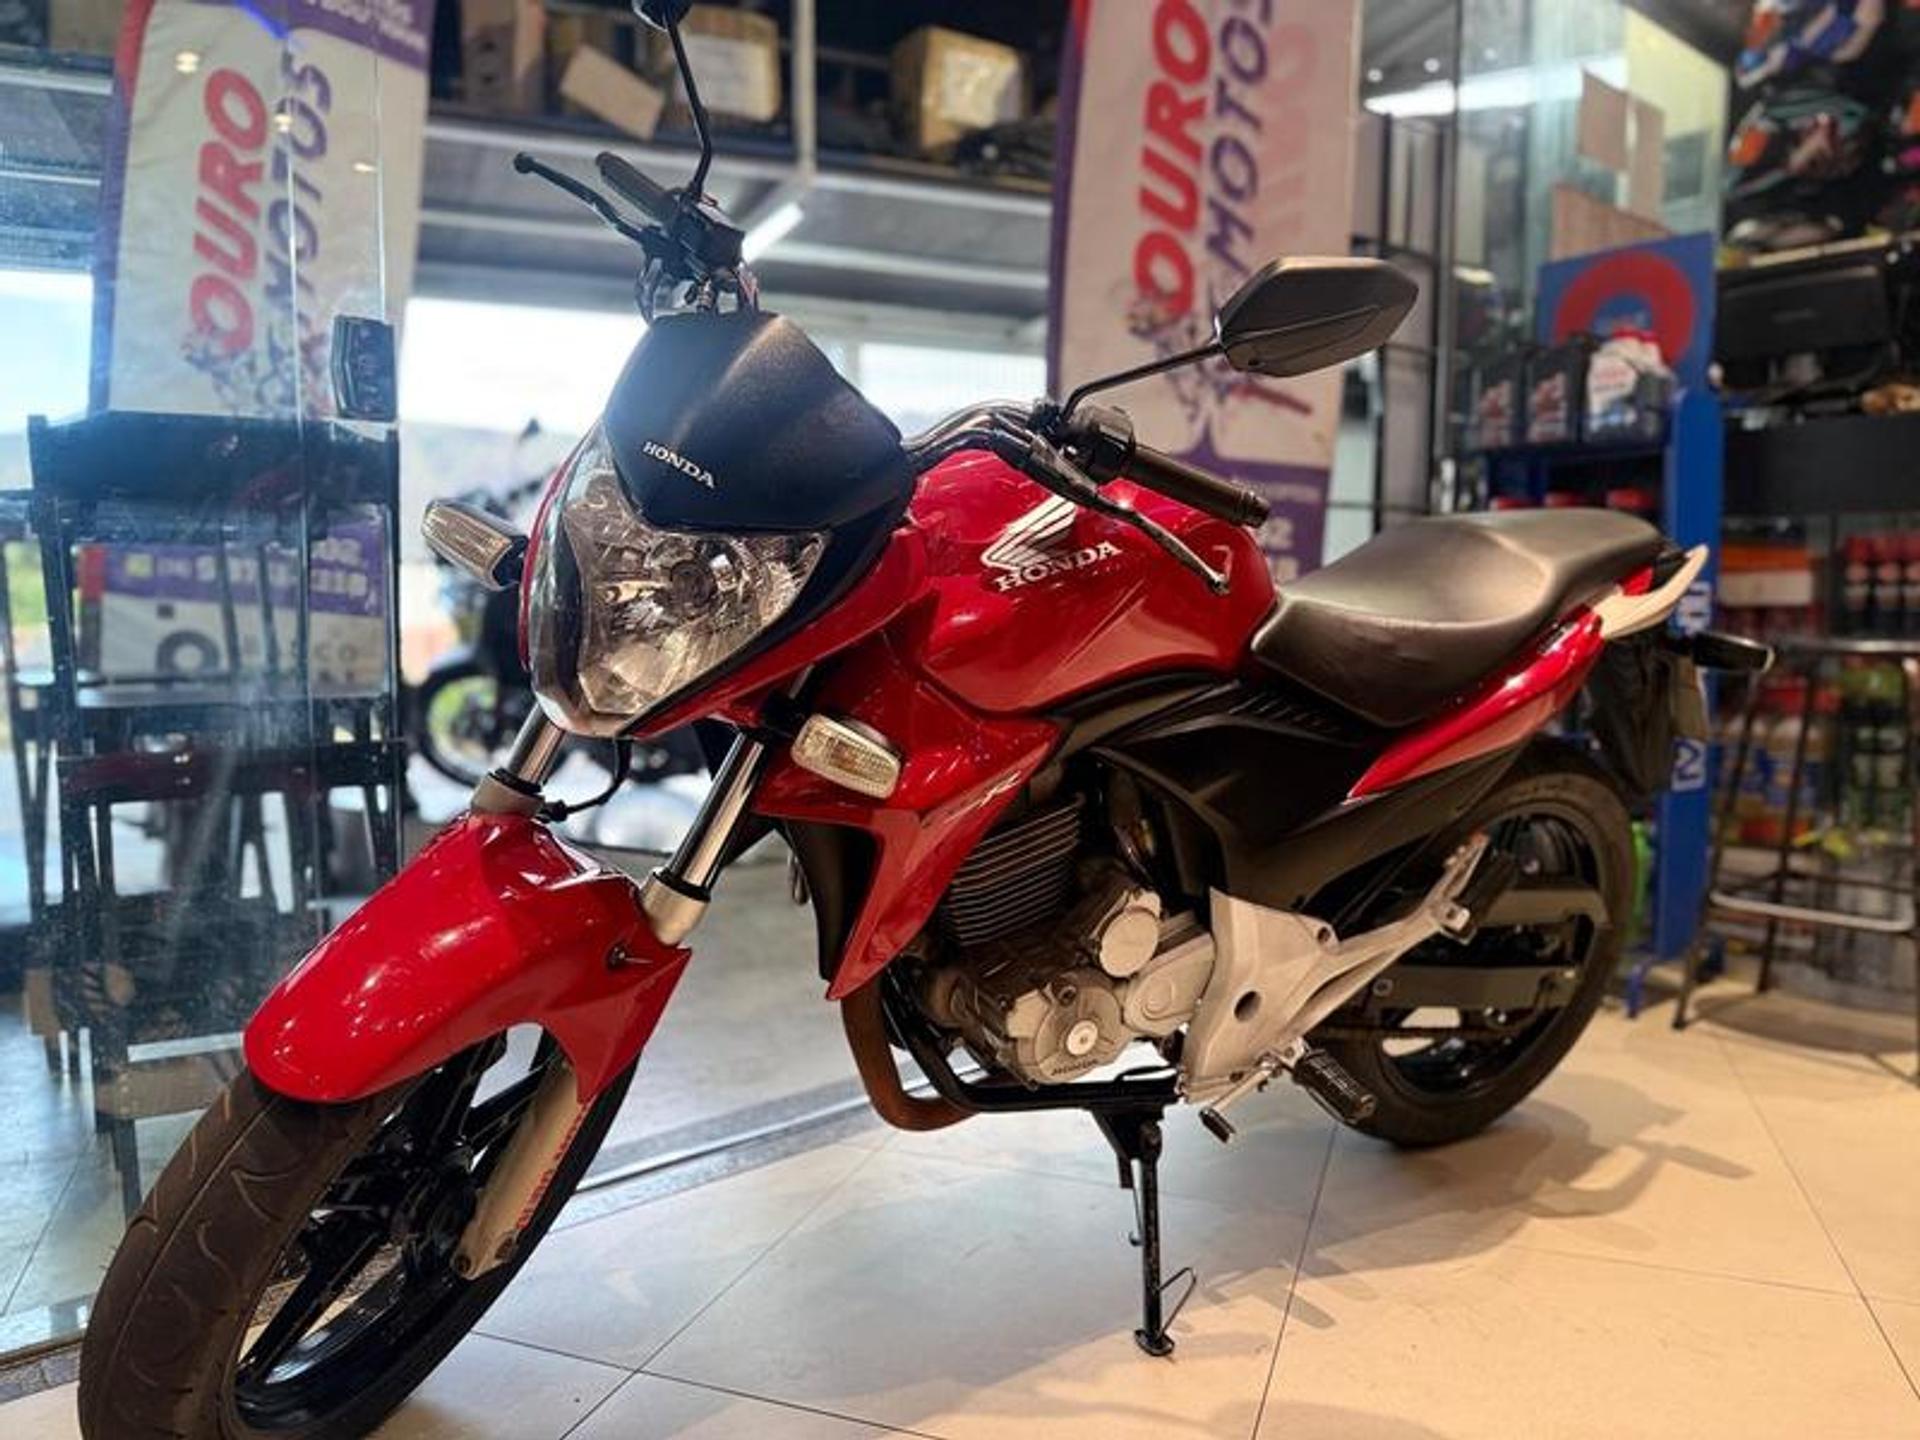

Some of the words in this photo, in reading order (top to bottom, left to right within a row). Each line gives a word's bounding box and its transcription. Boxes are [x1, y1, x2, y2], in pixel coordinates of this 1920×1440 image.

[190, 67, 268, 358] OURO
[264, 51, 332, 332] MOTOS
[1134, 0, 1212, 322] OURO
[642, 441, 714, 488] HONDA
[994, 540, 1123, 592] HONDA
